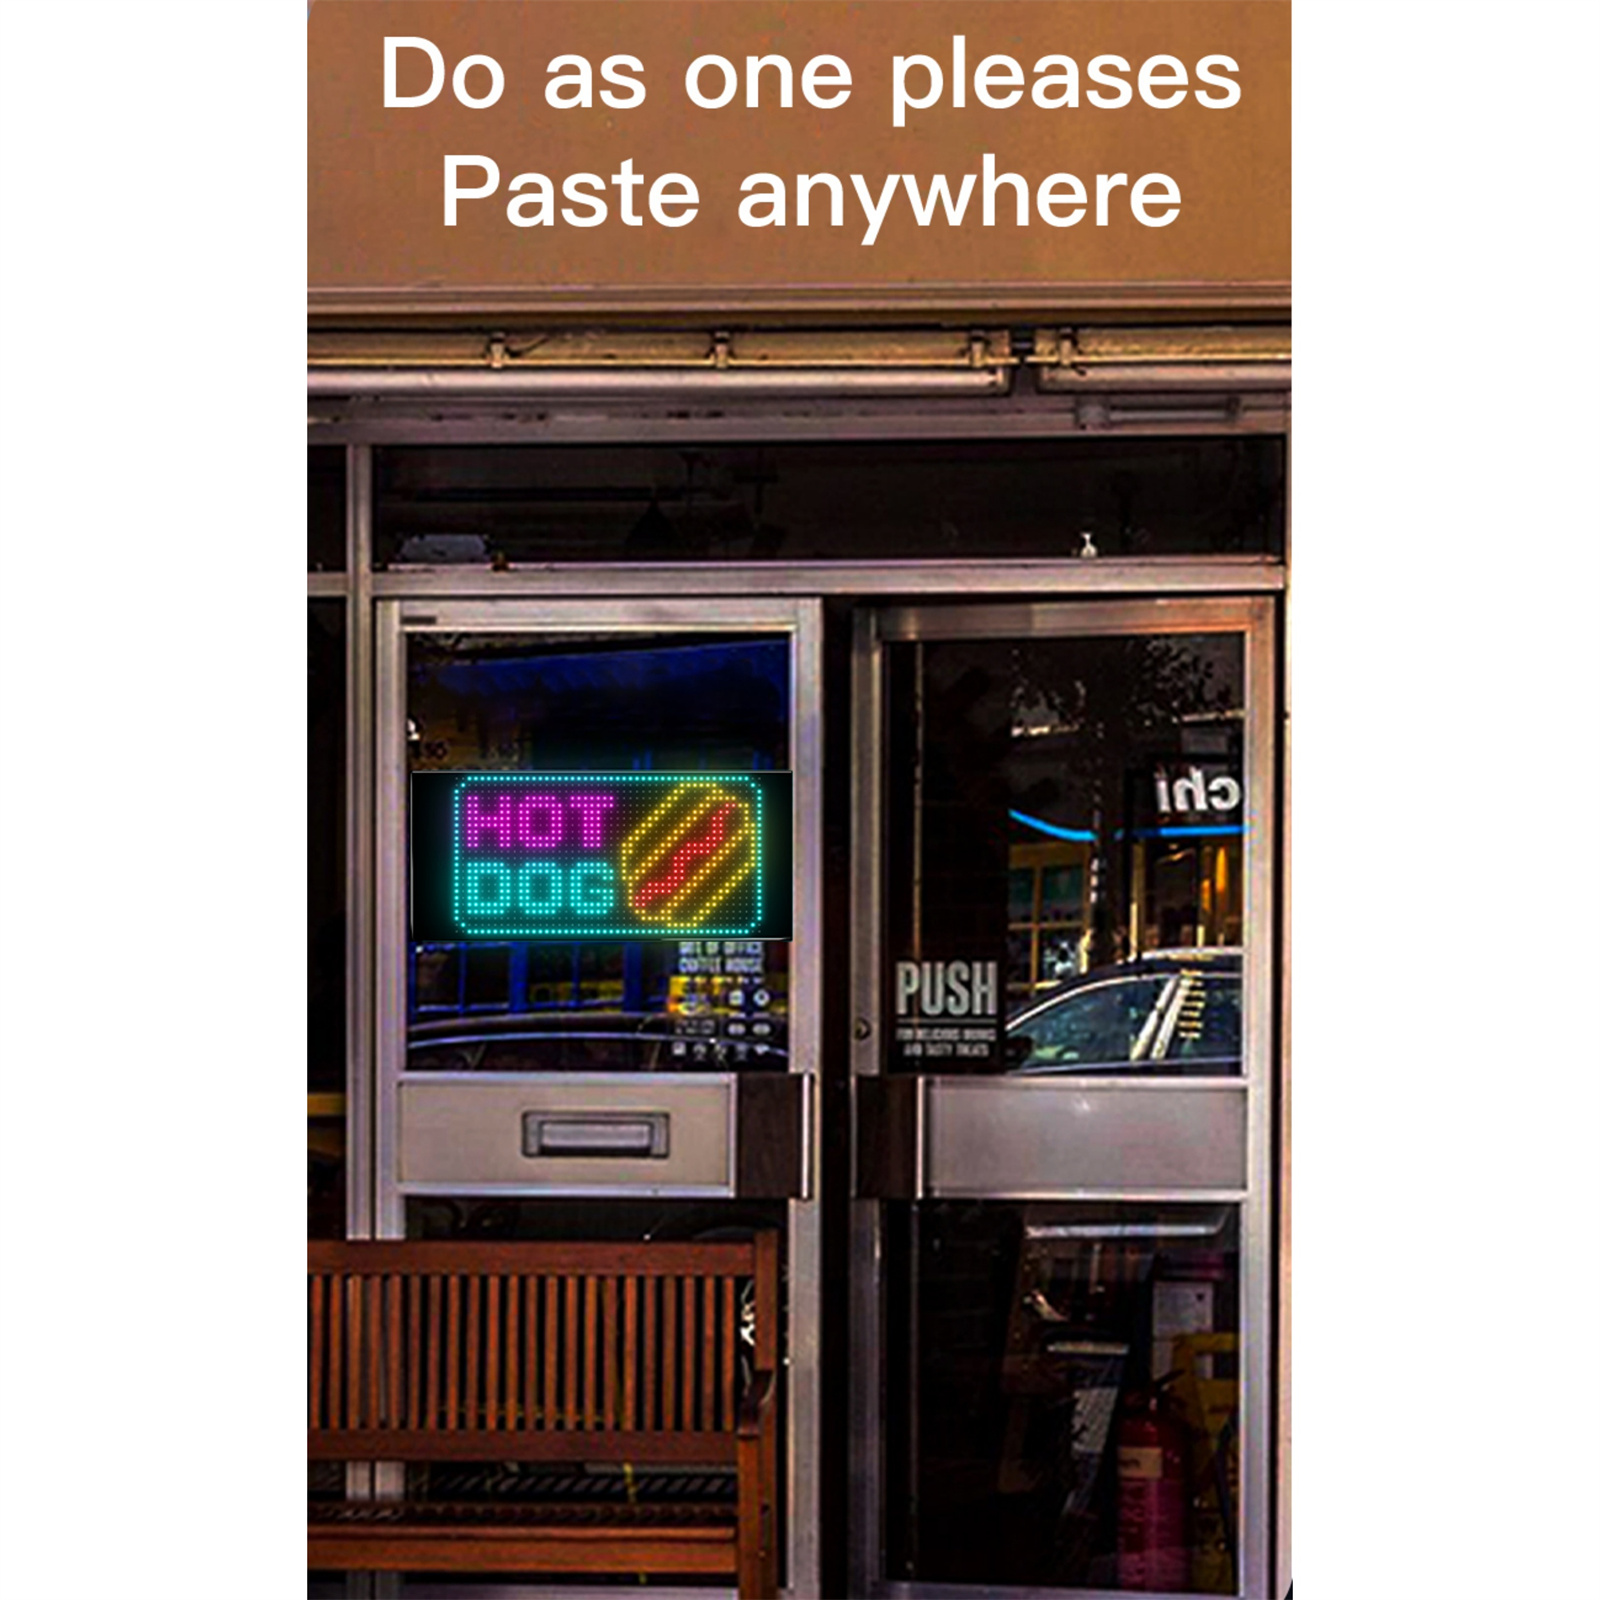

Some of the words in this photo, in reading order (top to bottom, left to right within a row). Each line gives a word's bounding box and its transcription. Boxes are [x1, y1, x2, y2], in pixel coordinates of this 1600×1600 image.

[467, 796, 614, 848] HOT
[467, 862, 614, 914] DOG
[895, 960, 998, 1017] PUSH
